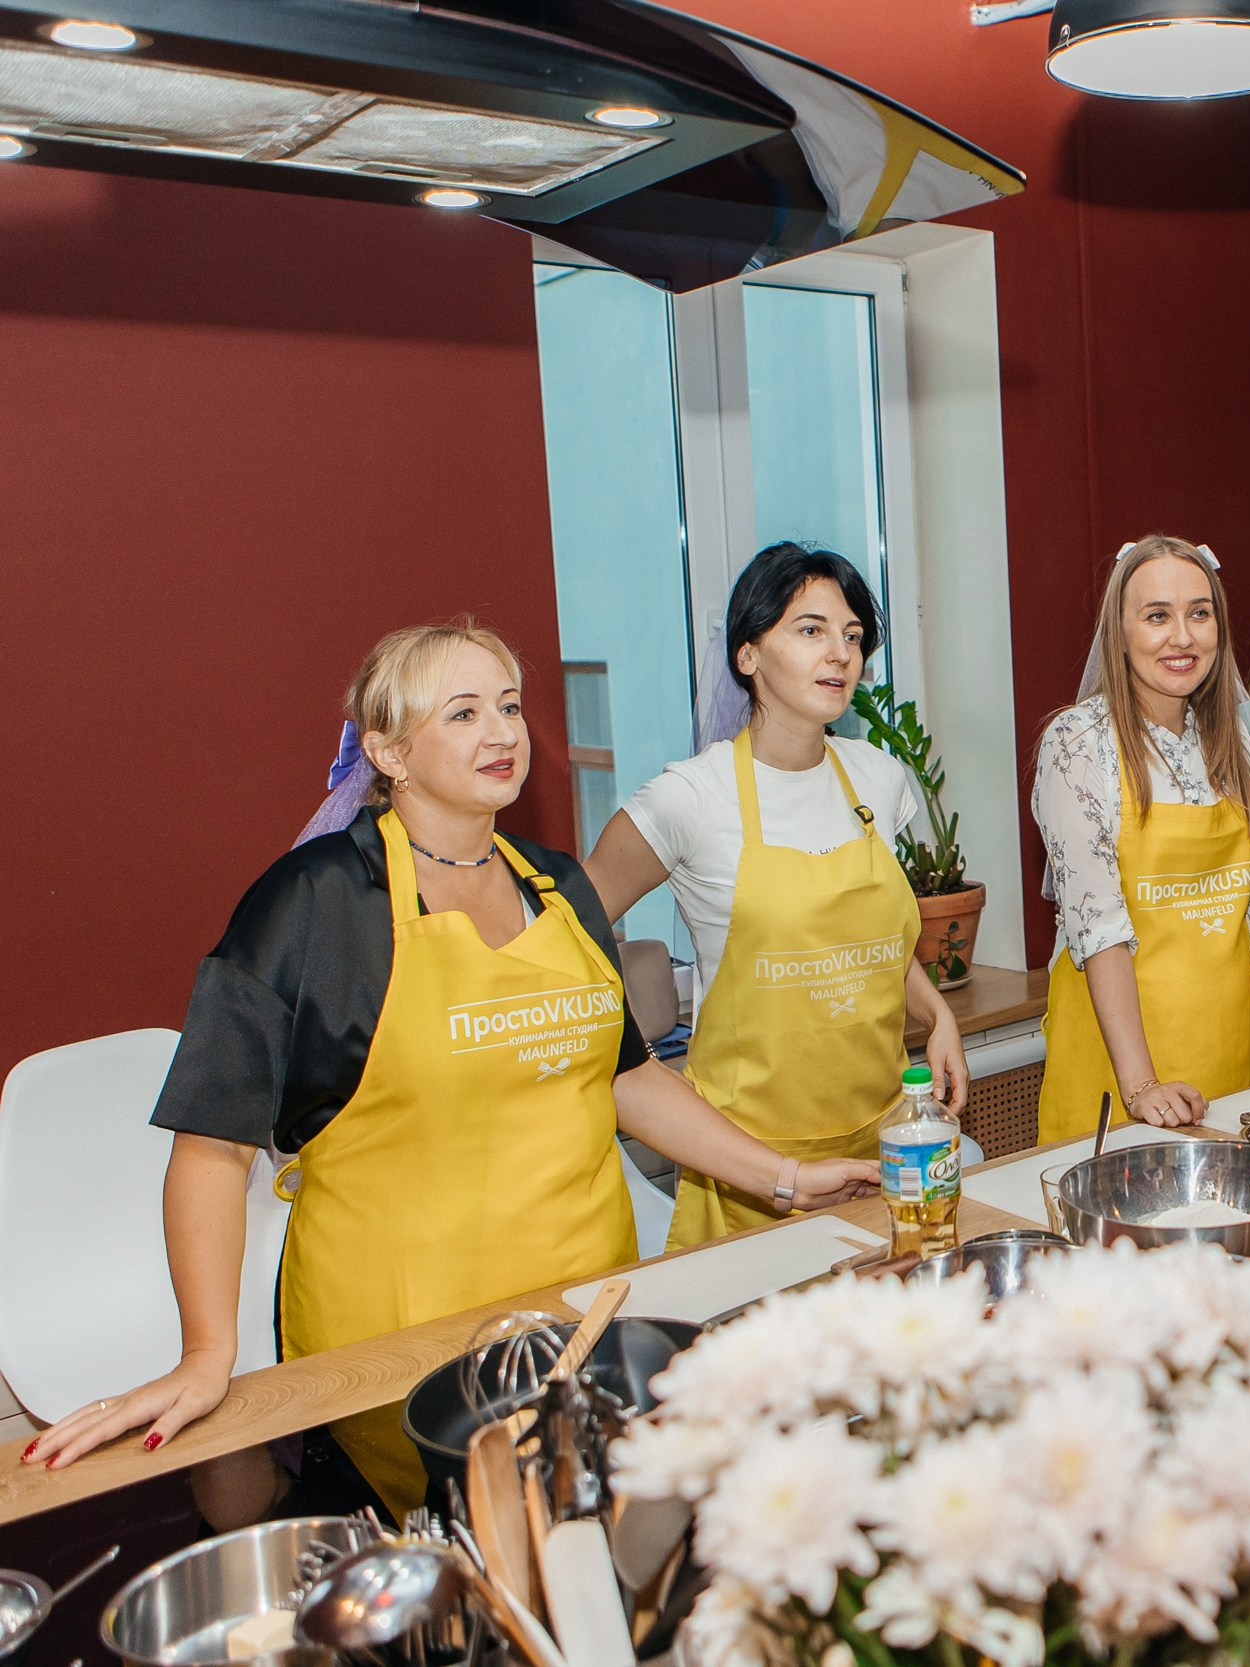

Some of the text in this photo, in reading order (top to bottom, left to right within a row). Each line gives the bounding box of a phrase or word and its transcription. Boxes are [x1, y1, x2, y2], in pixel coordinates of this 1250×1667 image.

[1181, 903, 1235, 920] MAUNFELD
[801, 975, 848, 987] КУЛИНАРНАЯ
[810, 980, 866, 1000] MAUNFELD
[449, 988, 621, 1042] ПростоVKUSNO
[508, 1022, 598, 1047] КУЛИНАРНАЯ СТУДИЯ
[518, 1038, 589, 1063] MAUNFELD
